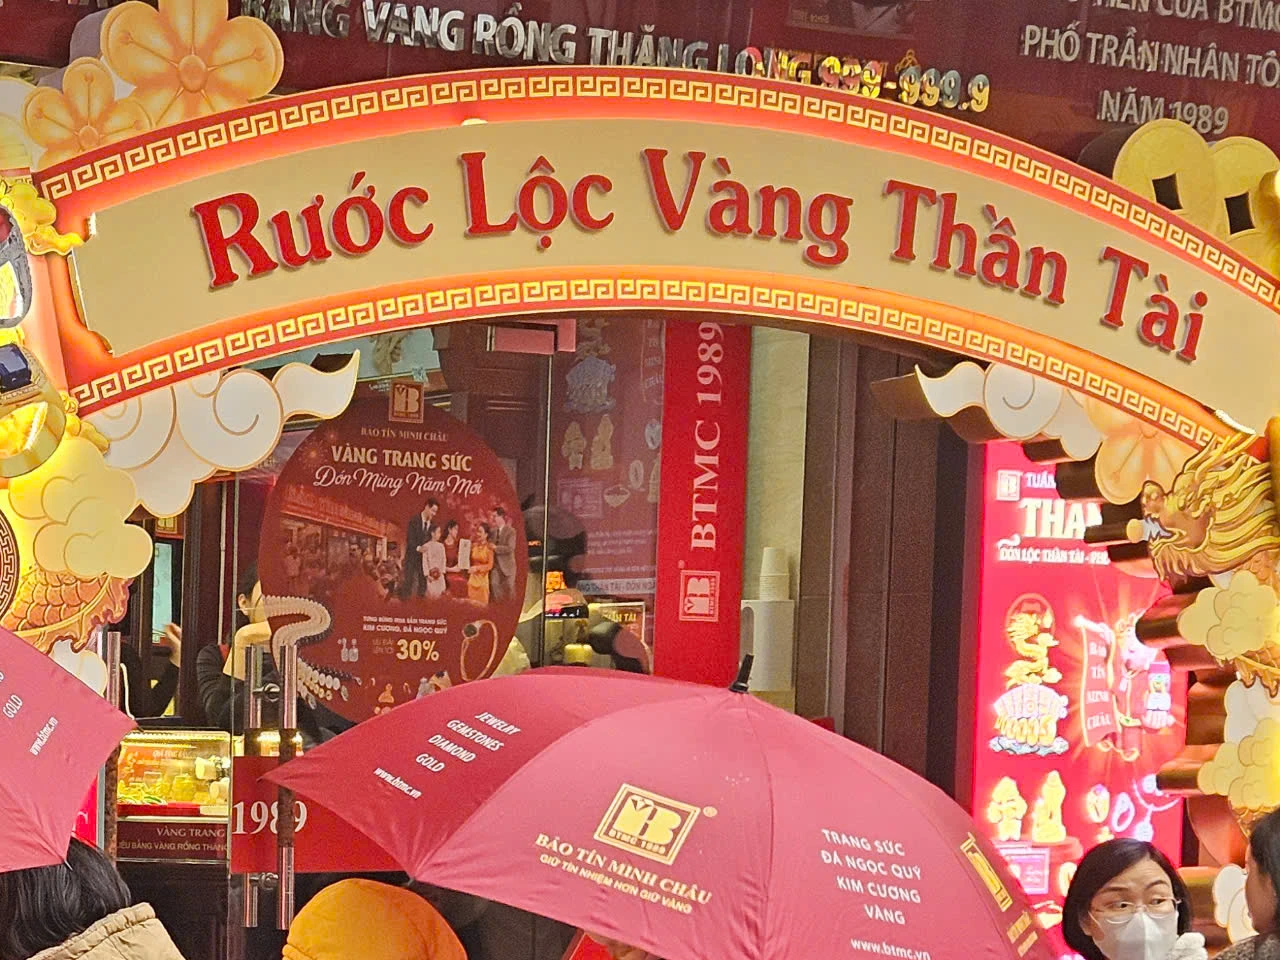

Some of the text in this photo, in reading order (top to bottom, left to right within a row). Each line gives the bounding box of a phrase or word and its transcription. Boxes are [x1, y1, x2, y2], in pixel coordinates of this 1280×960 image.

[587, 24, 708, 71] THĂNG
[1021, 20, 1081, 62] PHỐ
[1086, 26, 1161, 73] TRẦN
[1163, 42, 1239, 82] NHÂN
[1096, 86, 1229, 135] NĂM 1989
[193, 148, 1210, 362] Rước Lộc Vàng Thần Tài
[690, 320, 725, 551] BTMC 1989
[331, 442, 473, 472] VÀNG TRANG SỨC
[313, 465, 483, 497] Đón Mừng Năm Mới
[396, 638, 440, 661] 30%
[2, 694, 23, 719] GOLD
[447, 719, 505, 752] GEMSTONES
[474, 712, 521, 736] JEWELRY
[415, 753, 446, 773] GOLD
[428, 734, 476, 763] DIAMOND
[157, 825, 226, 838] VÀNG TRANG
[822, 829, 906, 857] TRANG SỨC
[535, 832, 713, 906] BẢO TÍN MINH CHÂU
[821, 849, 922, 881] ĐÁ NGỌC QUÝ
[837, 875, 921, 904] KIM CƯƠNG
[864, 903, 906, 925] VÀNG
